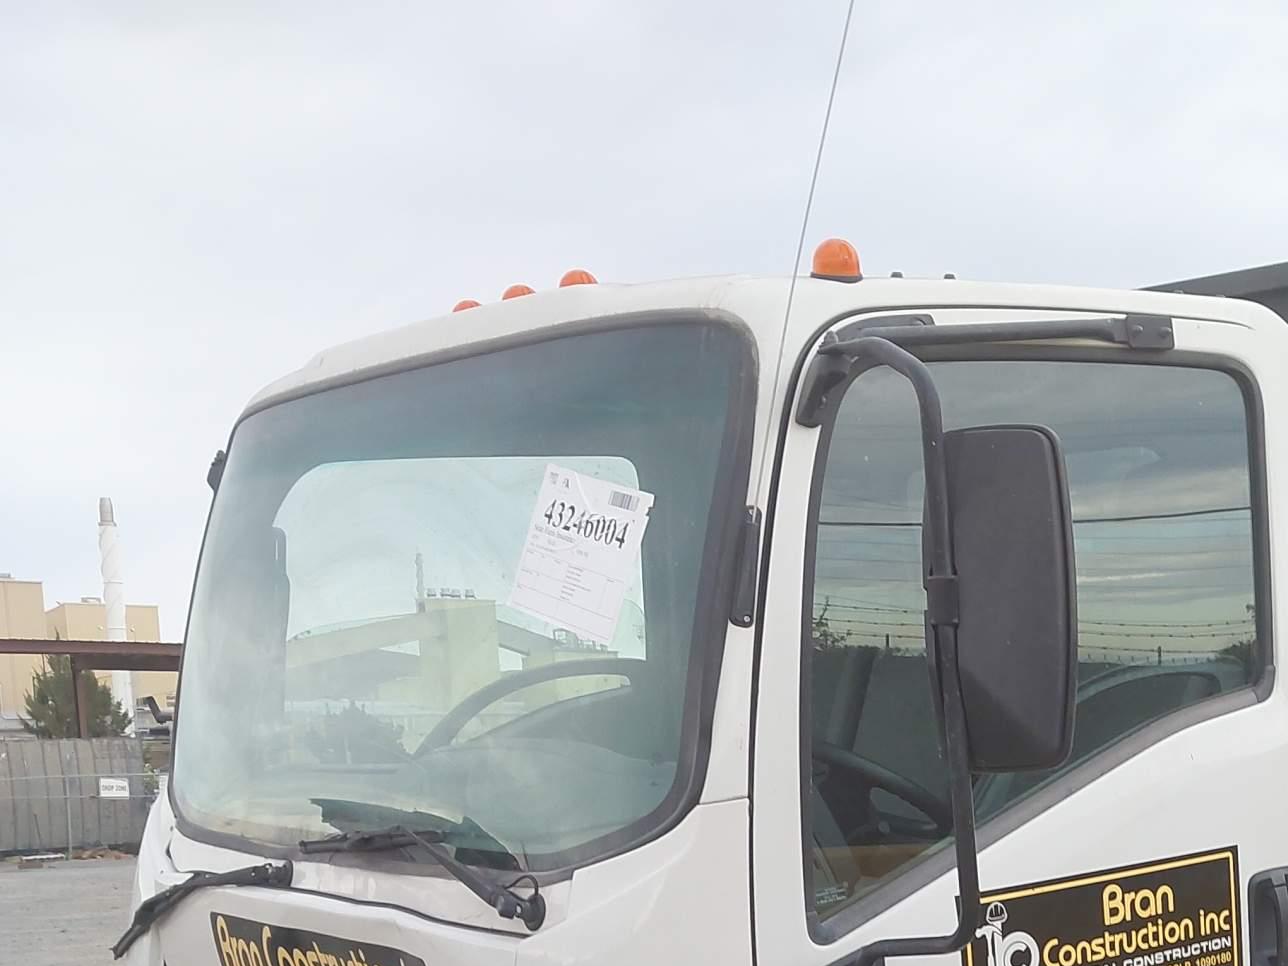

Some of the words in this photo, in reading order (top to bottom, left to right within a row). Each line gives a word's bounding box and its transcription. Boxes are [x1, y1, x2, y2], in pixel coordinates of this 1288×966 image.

[544, 499, 628, 549] 43246004
[1103, 883, 1175, 926] Bran
[1200, 909, 1231, 935] inc
